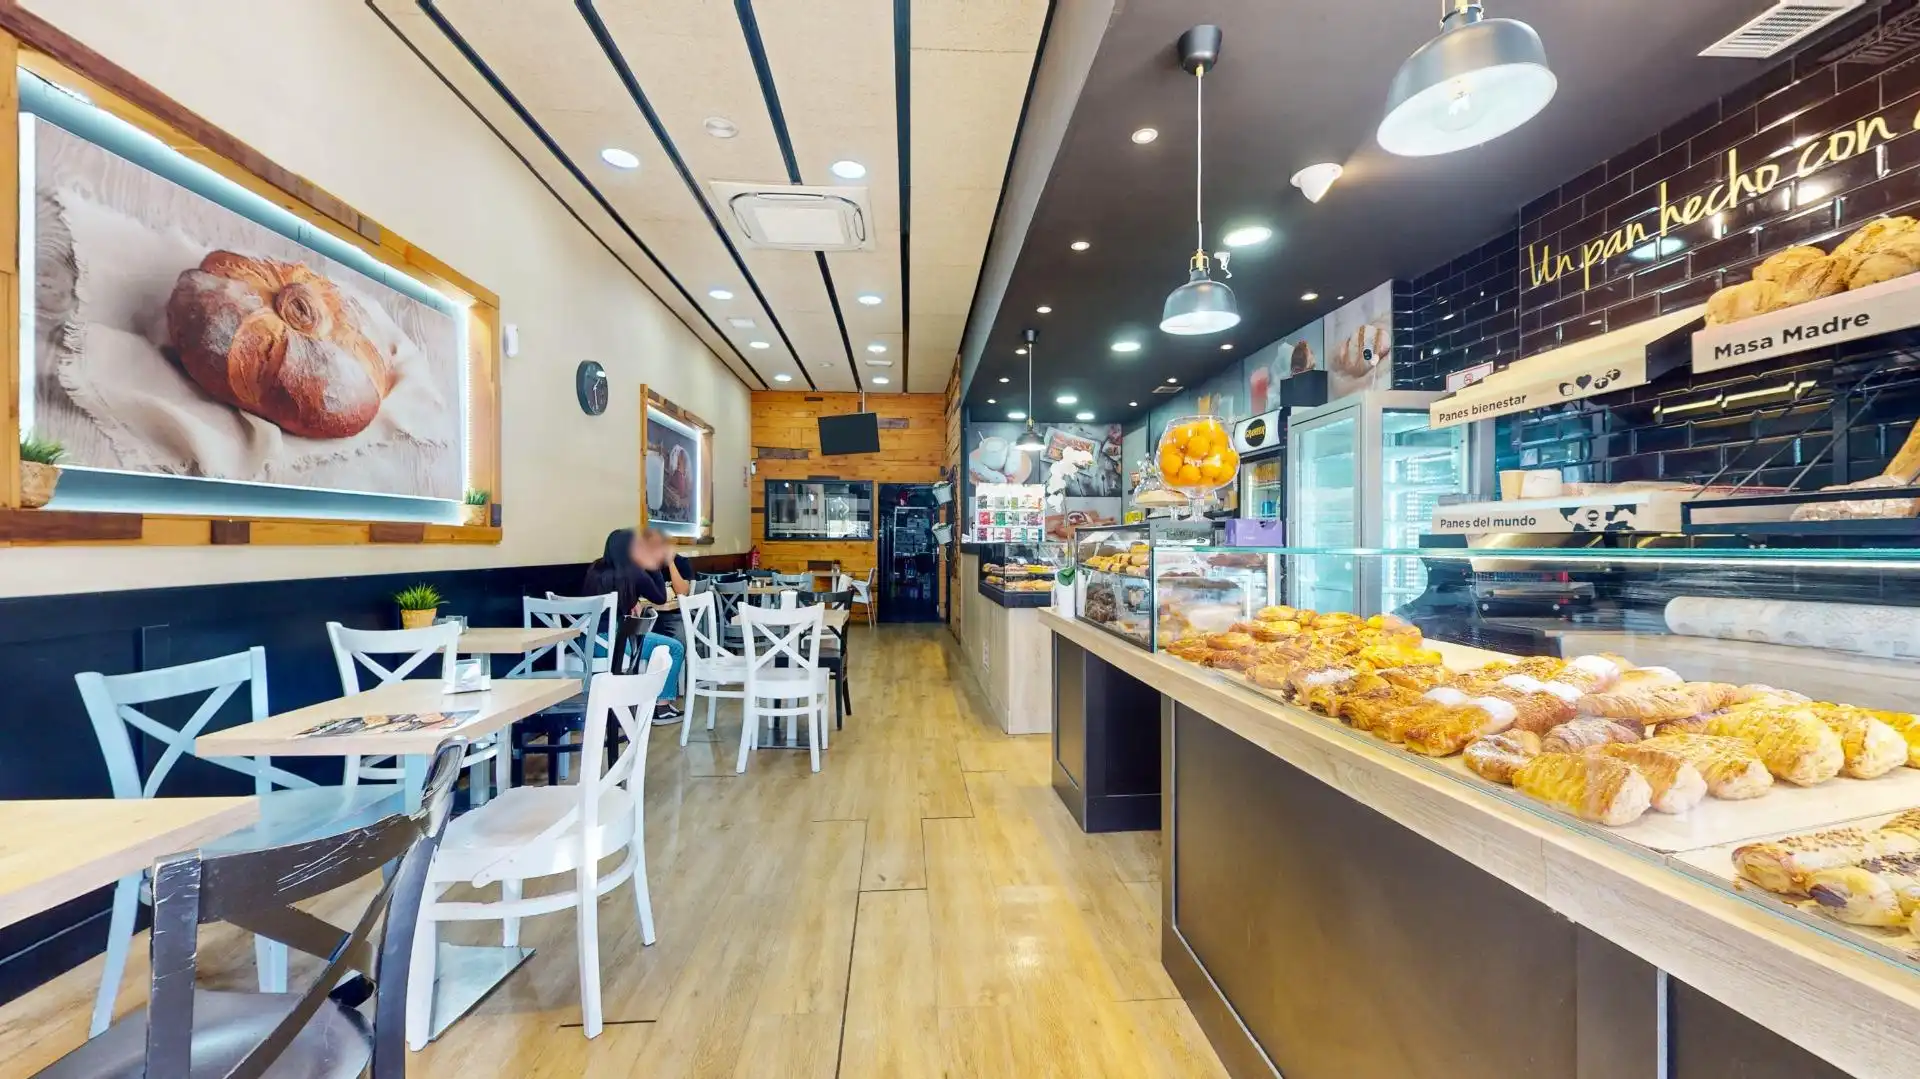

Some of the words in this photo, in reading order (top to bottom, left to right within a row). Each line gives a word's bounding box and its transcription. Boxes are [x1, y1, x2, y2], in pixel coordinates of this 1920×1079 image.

[1529, 243, 1575, 287] Un
[1581, 221, 1649, 291] pan
[1660, 148, 1780, 237] hecho
[1796, 116, 1898, 178] con
[1714, 336, 1774, 361] Masa
[1782, 312, 1870, 345] Madre
[1438, 408, 1469, 424] Panes
[1471, 394, 1528, 416] bienestar
[1440, 517, 1471, 529] Panes
[1472, 515, 1490, 528] del
[1493, 514, 1537, 527] mundo
